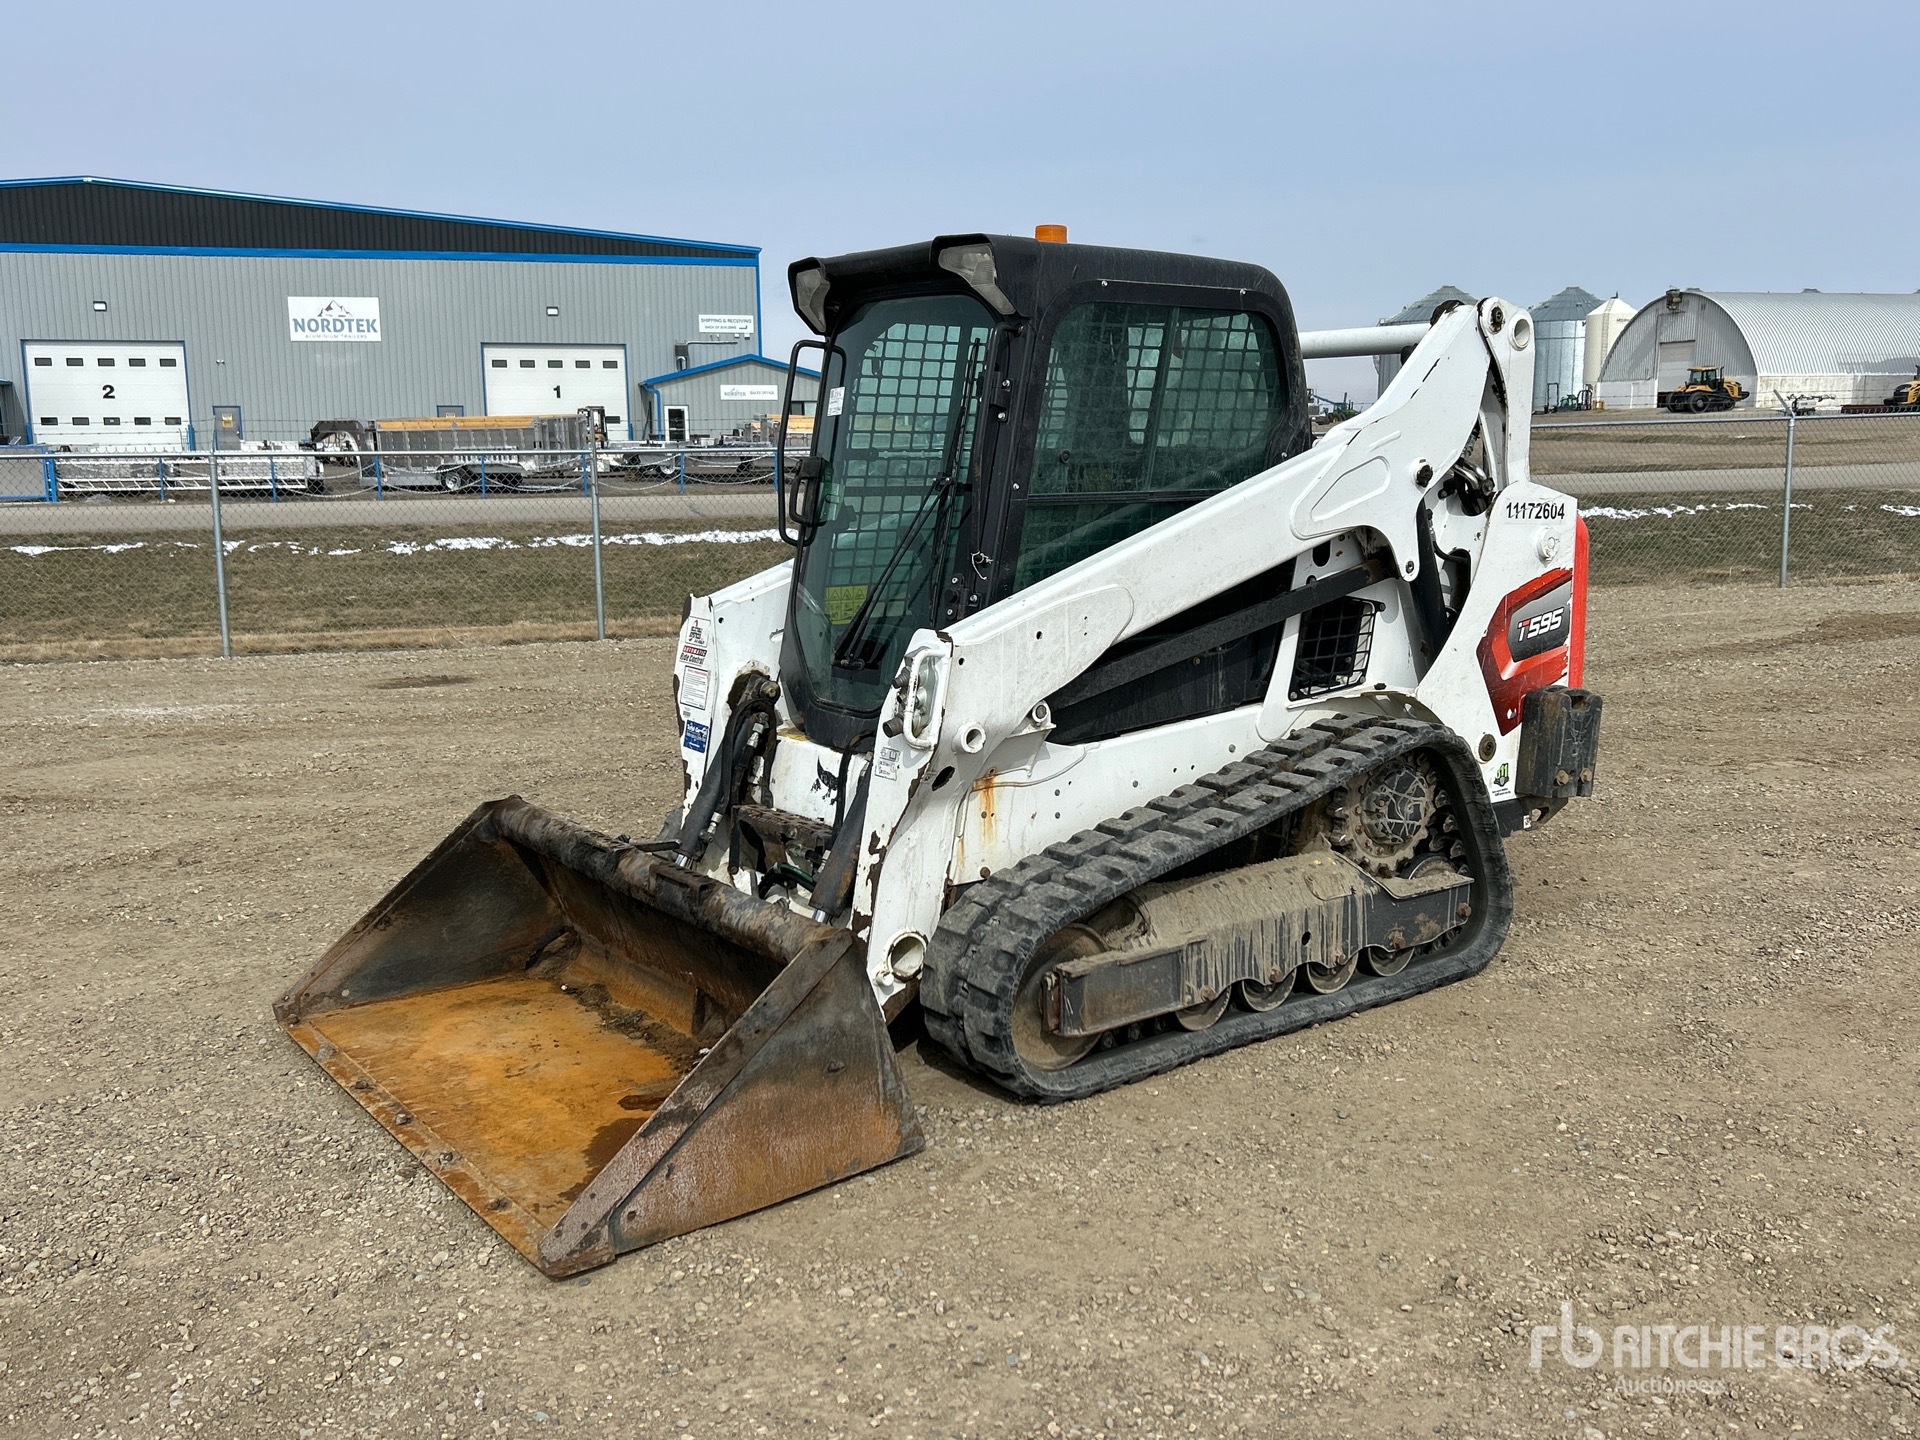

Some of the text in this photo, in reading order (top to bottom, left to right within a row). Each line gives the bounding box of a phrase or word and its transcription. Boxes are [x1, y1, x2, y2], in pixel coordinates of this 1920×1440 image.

[292, 318, 378, 333] NORDTEK
[102, 384, 116, 399] 2
[553, 385, 561, 399] 1
[1506, 502, 1565, 520] 11172604
[1517, 606, 1565, 642] T595
